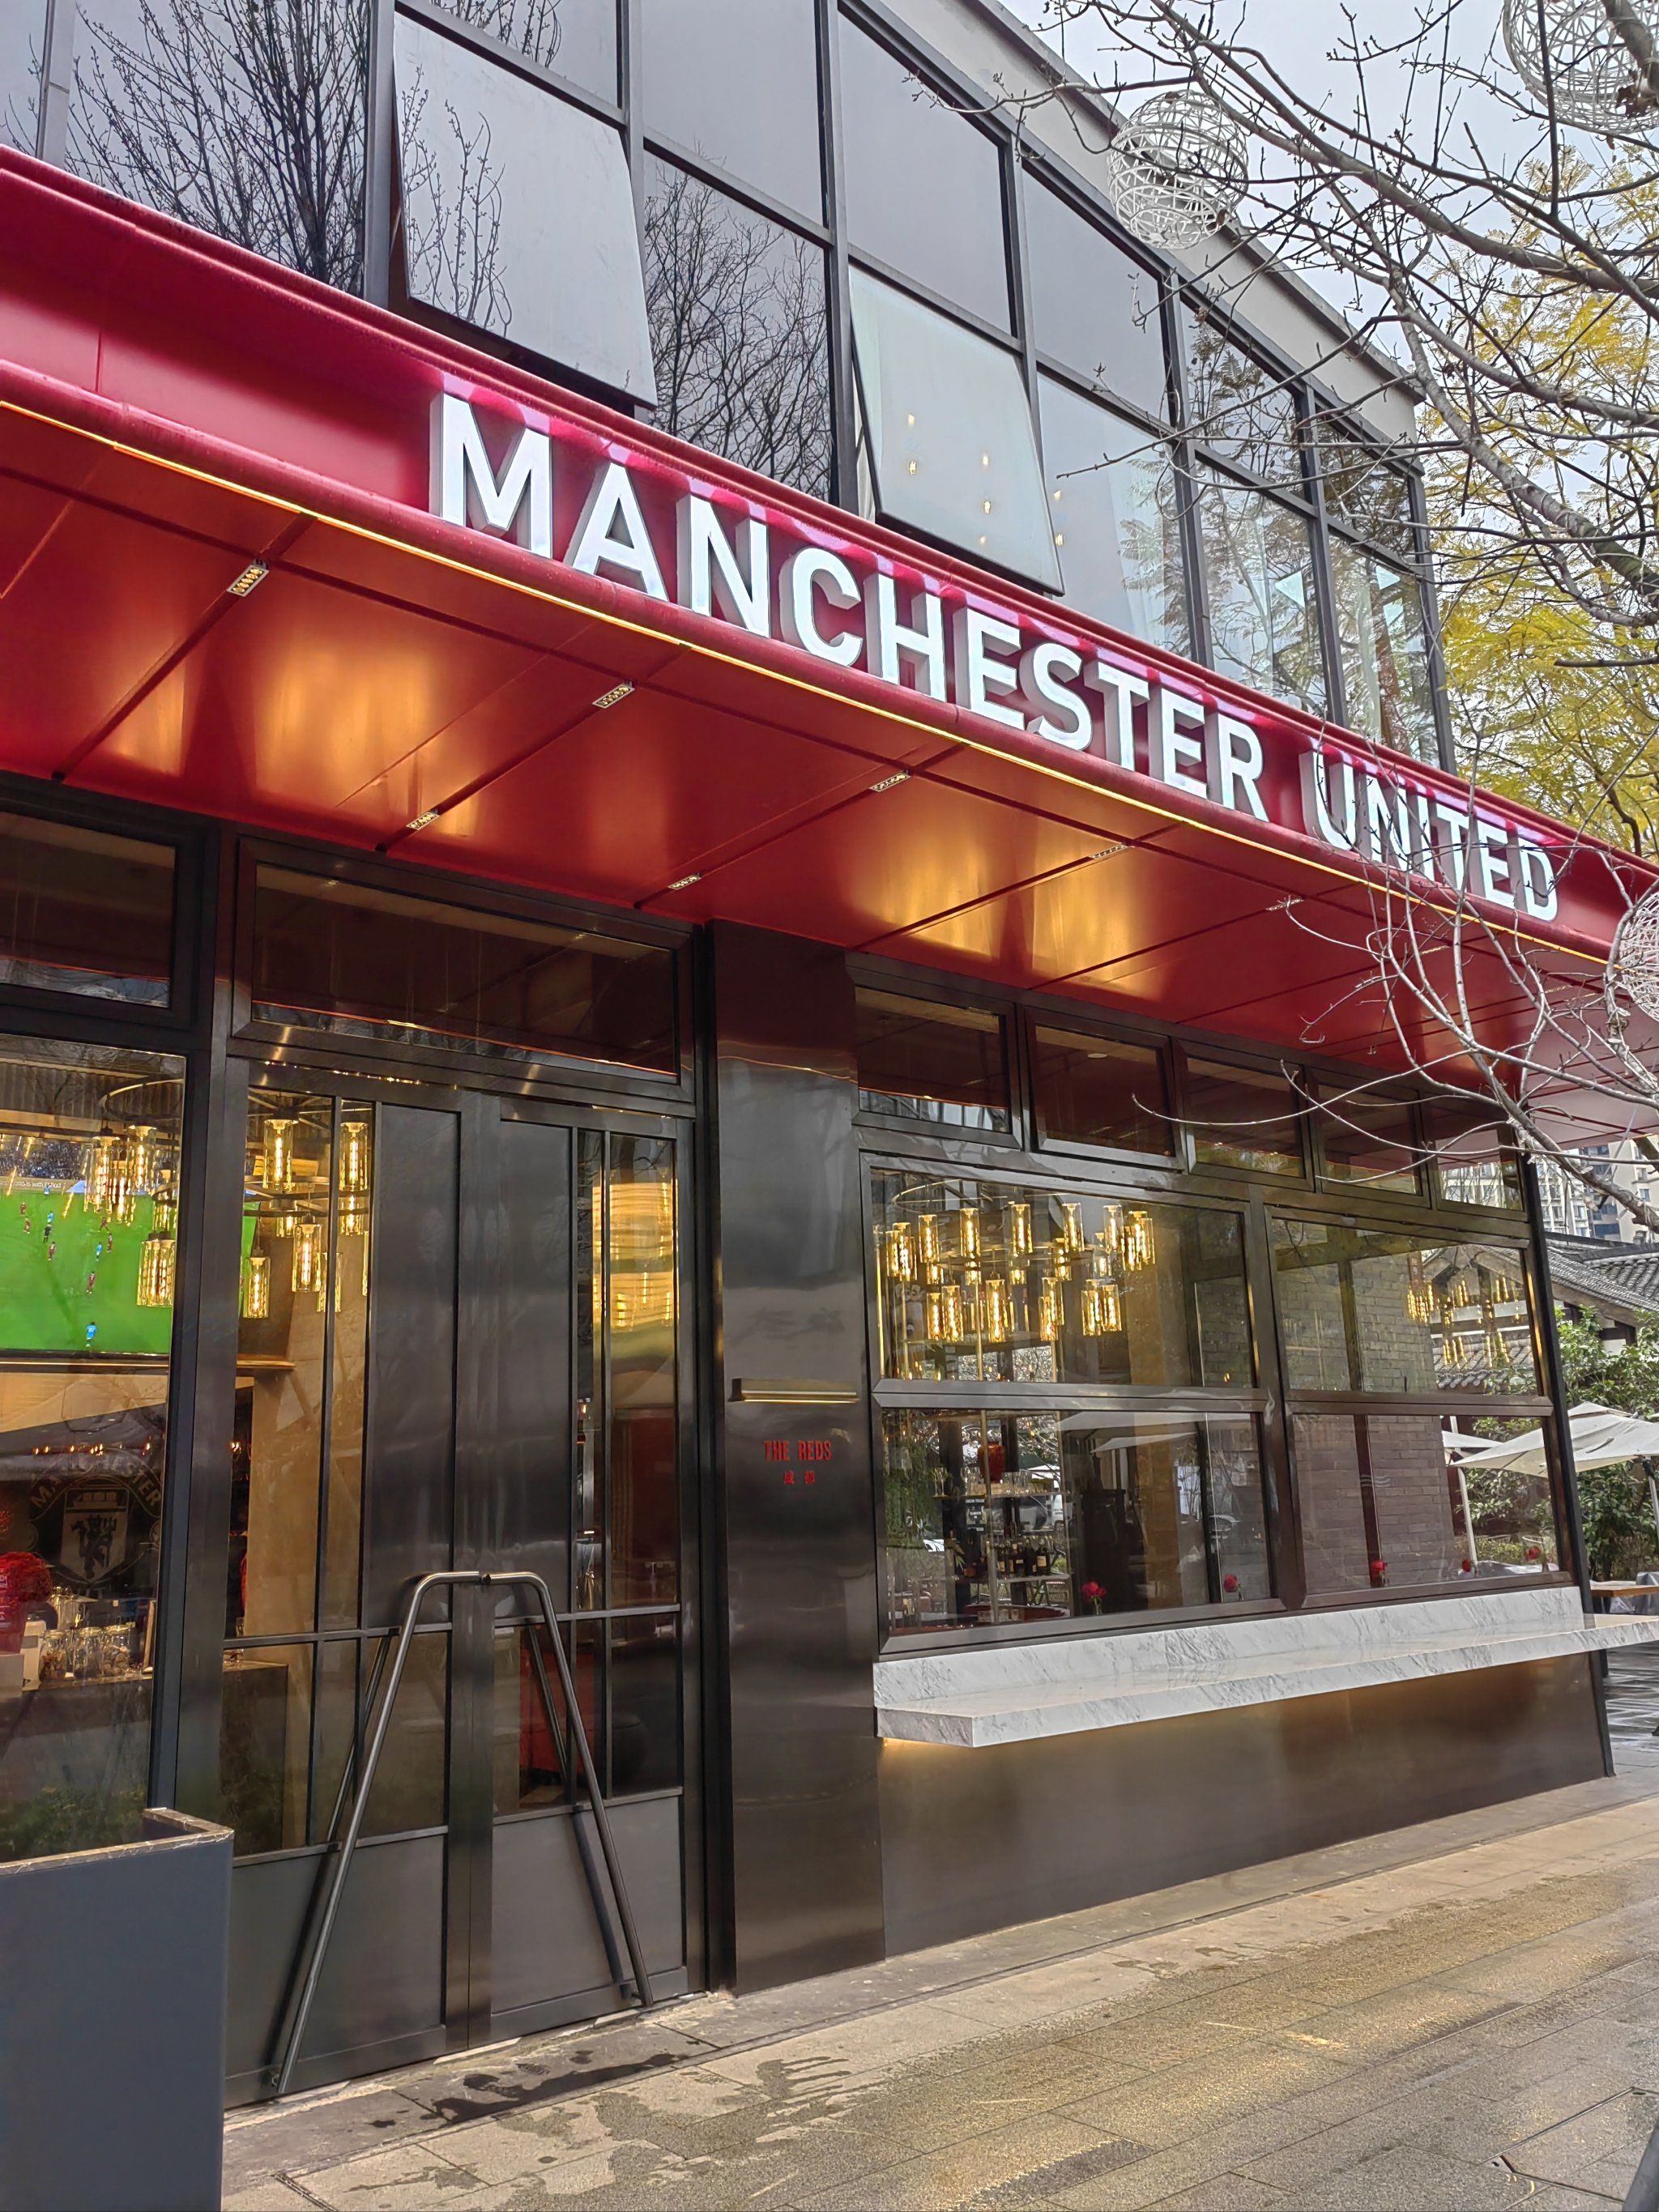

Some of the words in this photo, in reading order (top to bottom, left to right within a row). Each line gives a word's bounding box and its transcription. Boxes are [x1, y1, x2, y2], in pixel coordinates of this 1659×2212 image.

[431, 390, 1269, 823] MANCHESTER
[1299, 750, 1557, 921] UNITED
[765, 1440, 791, 1461] THE
[798, 1440, 831, 1461] REDS
